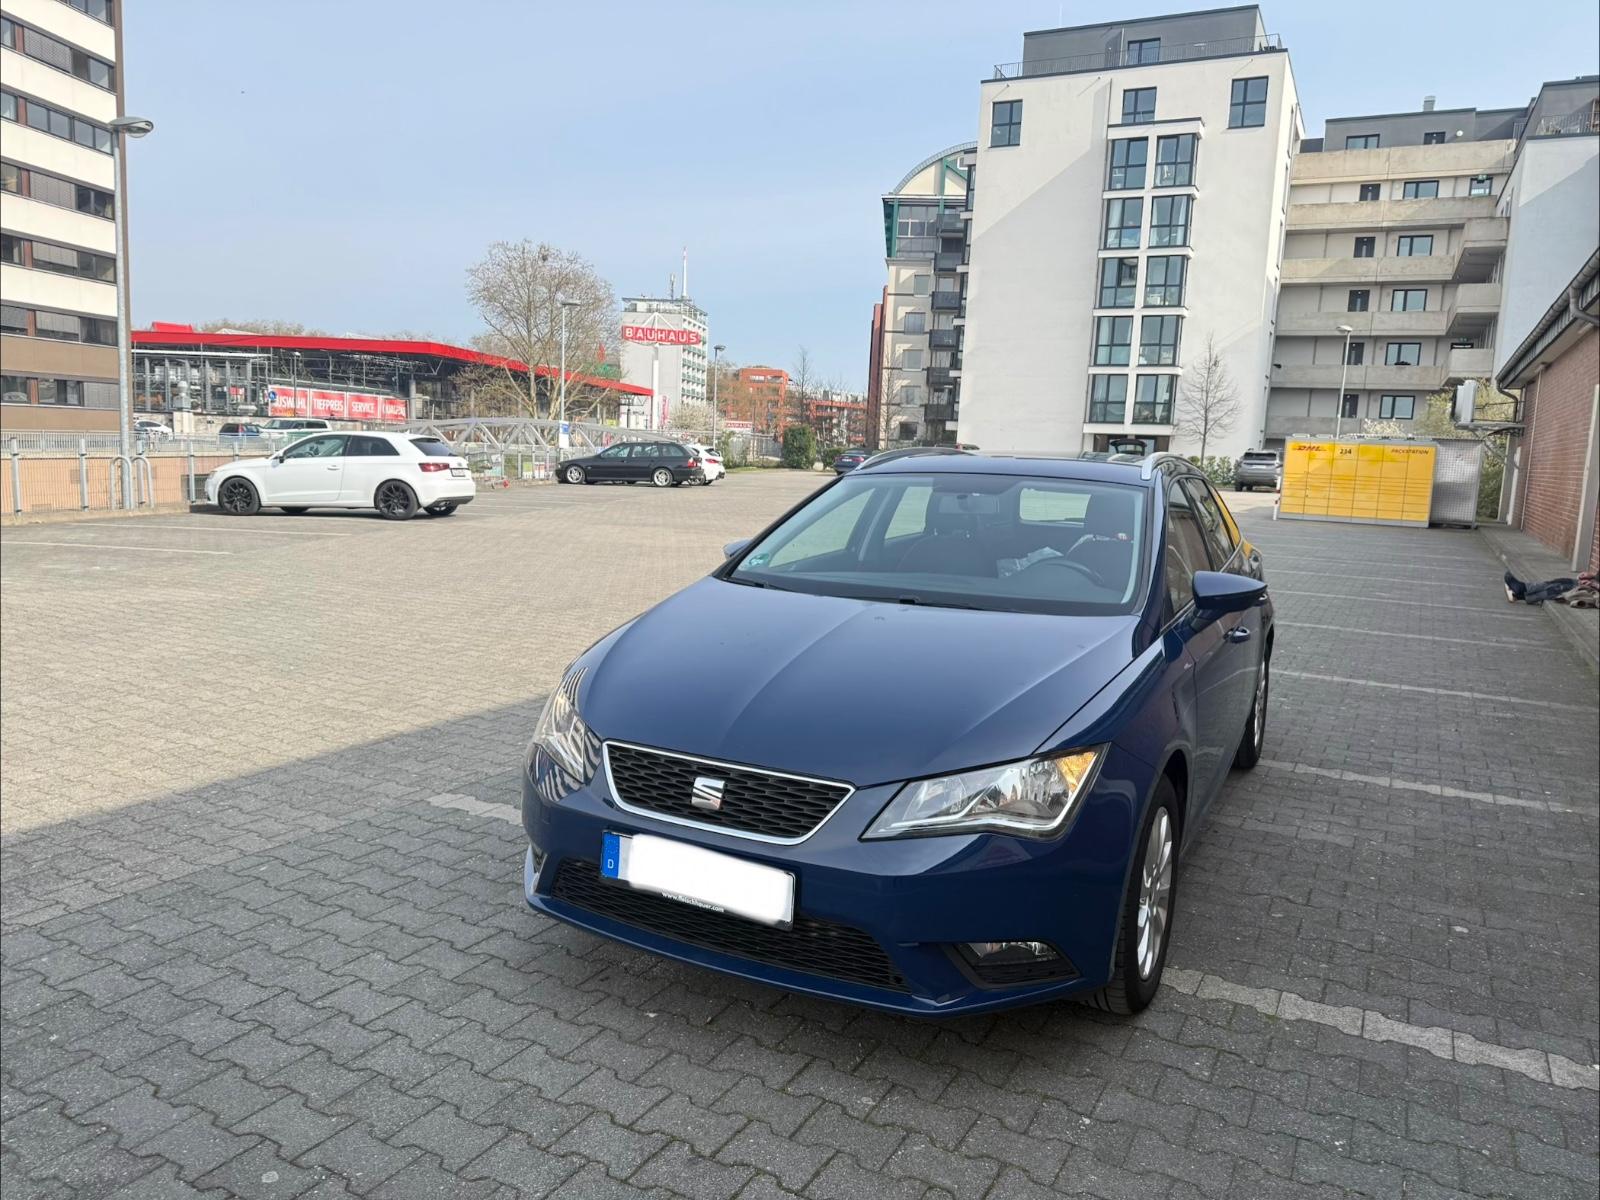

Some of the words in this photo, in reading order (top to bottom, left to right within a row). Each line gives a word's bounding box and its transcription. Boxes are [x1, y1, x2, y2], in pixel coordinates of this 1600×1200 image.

[625, 327, 697, 342] BAUHAUS
[351, 401, 375, 413] SERVICE
[607, 858, 614, 869] D
